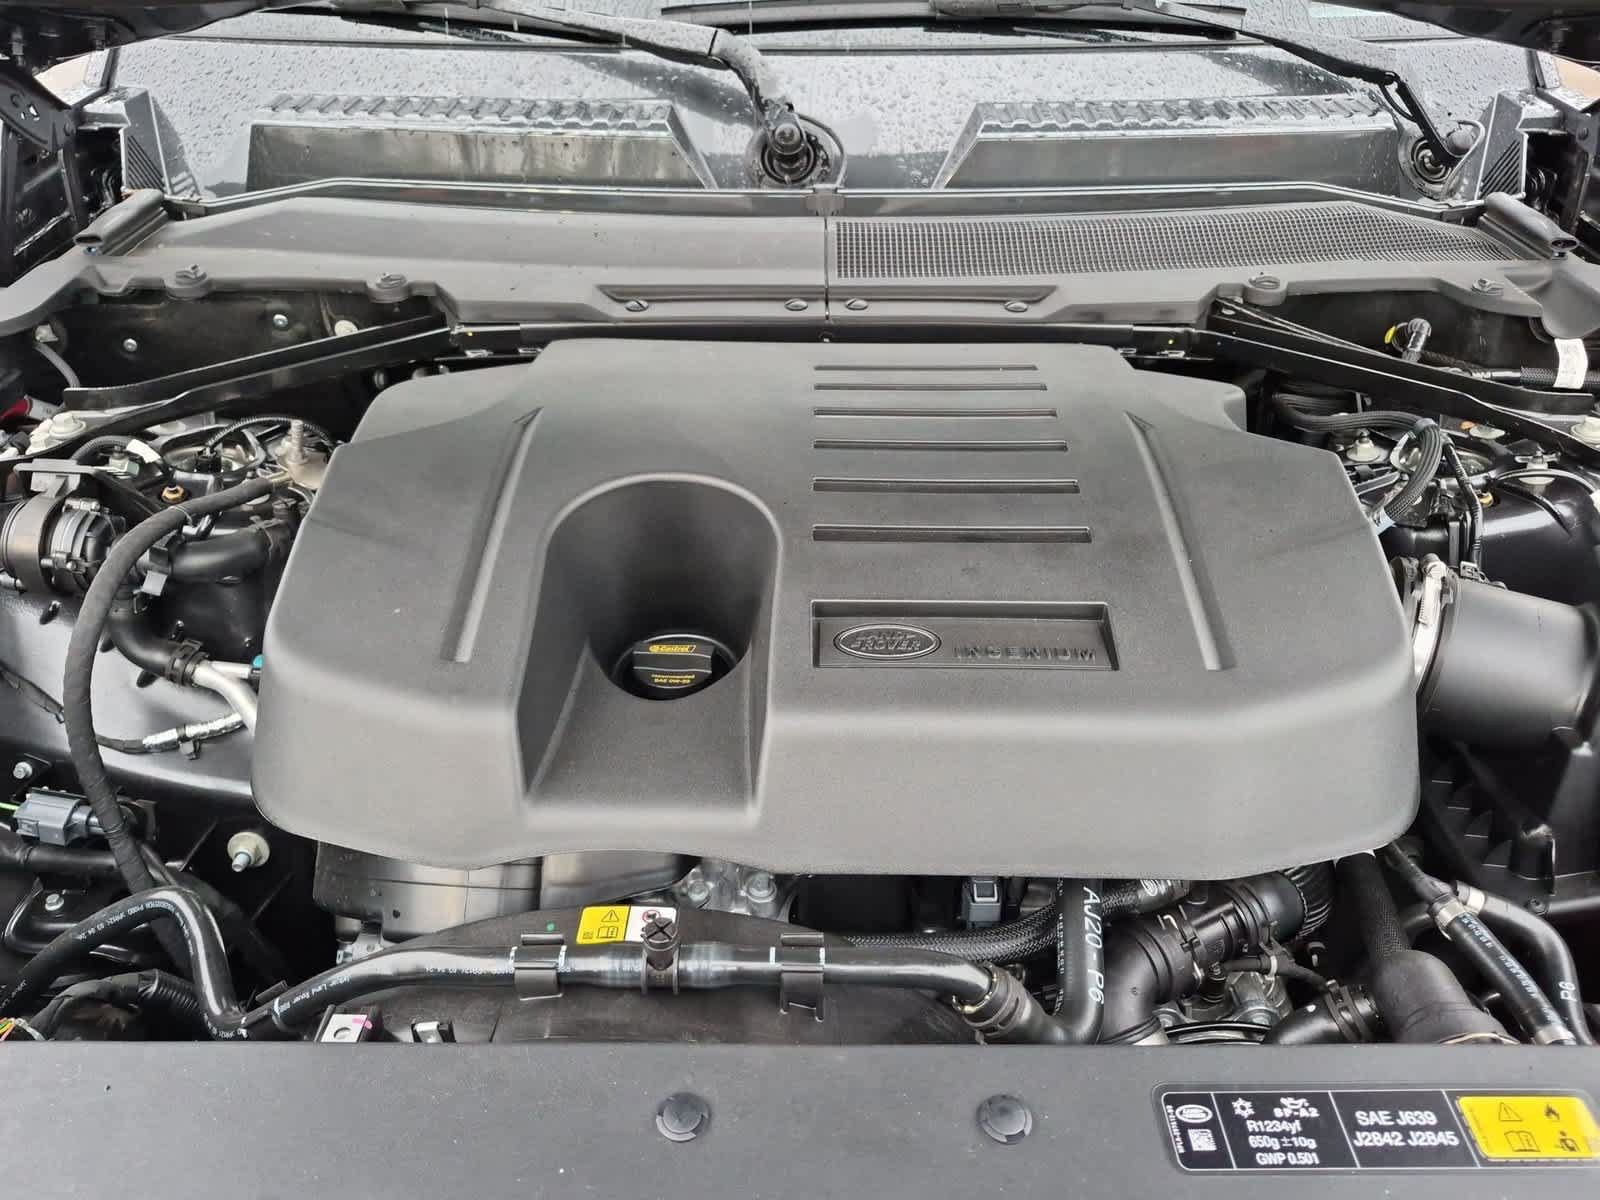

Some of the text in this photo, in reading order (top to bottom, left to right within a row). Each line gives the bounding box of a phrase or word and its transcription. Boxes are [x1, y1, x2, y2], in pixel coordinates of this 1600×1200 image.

[856, 631, 905, 640] LAND
[658, 644, 689, 653] Castrol
[860, 640, 921, 651] ROVER
[954, 647, 1096, 662] INGENIUM
[1559, 981, 1577, 1001] P6
[1356, 1110, 1438, 1126] SAE J639
[1246, 1119, 1302, 1134] R1234yf
[1248, 1135, 1280, 1150] 650g
[1353, 1130, 1460, 1147] J2842 J2845
[1255, 1152, 1320, 1165] GWP 0.501
